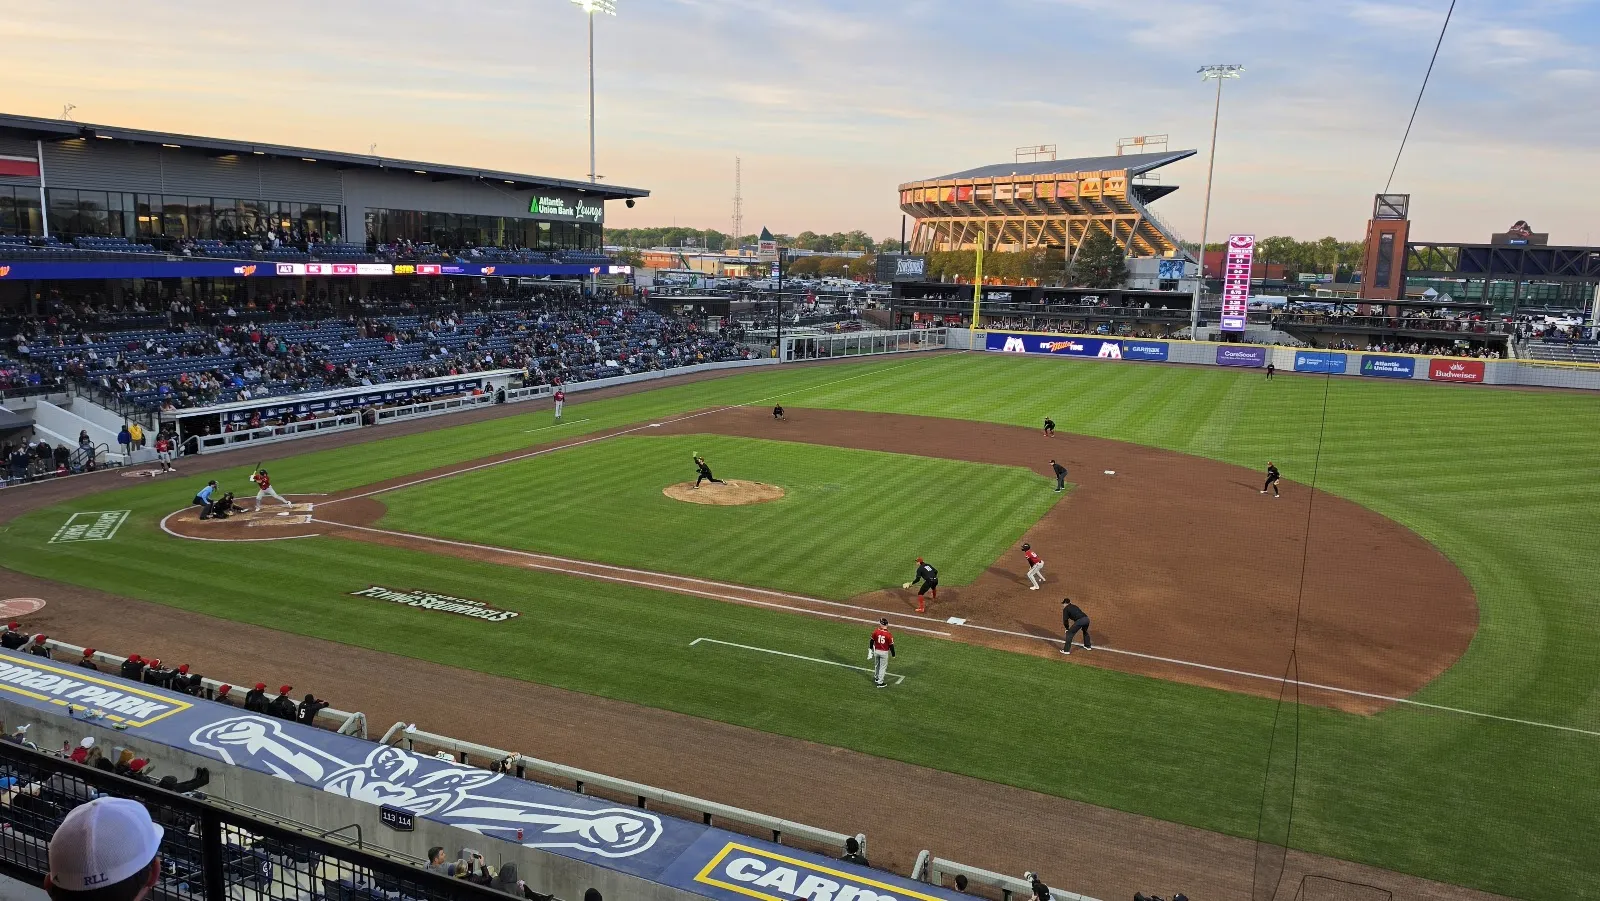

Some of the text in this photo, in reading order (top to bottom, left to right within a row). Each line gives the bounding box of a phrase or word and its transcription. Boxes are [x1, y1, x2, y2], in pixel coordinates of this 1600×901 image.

[539, 197, 564, 206] Atlantic
[539, 205, 574, 216] Union Bank
[575, 200, 602, 222] Lounge
[1435, 369, 1477, 379] Budweiser
[64, 685, 169, 719] PARK
[299, 708, 306, 719] 5
[383, 812, 411, 827] 113 114
[83, 872, 109, 886] RLL
